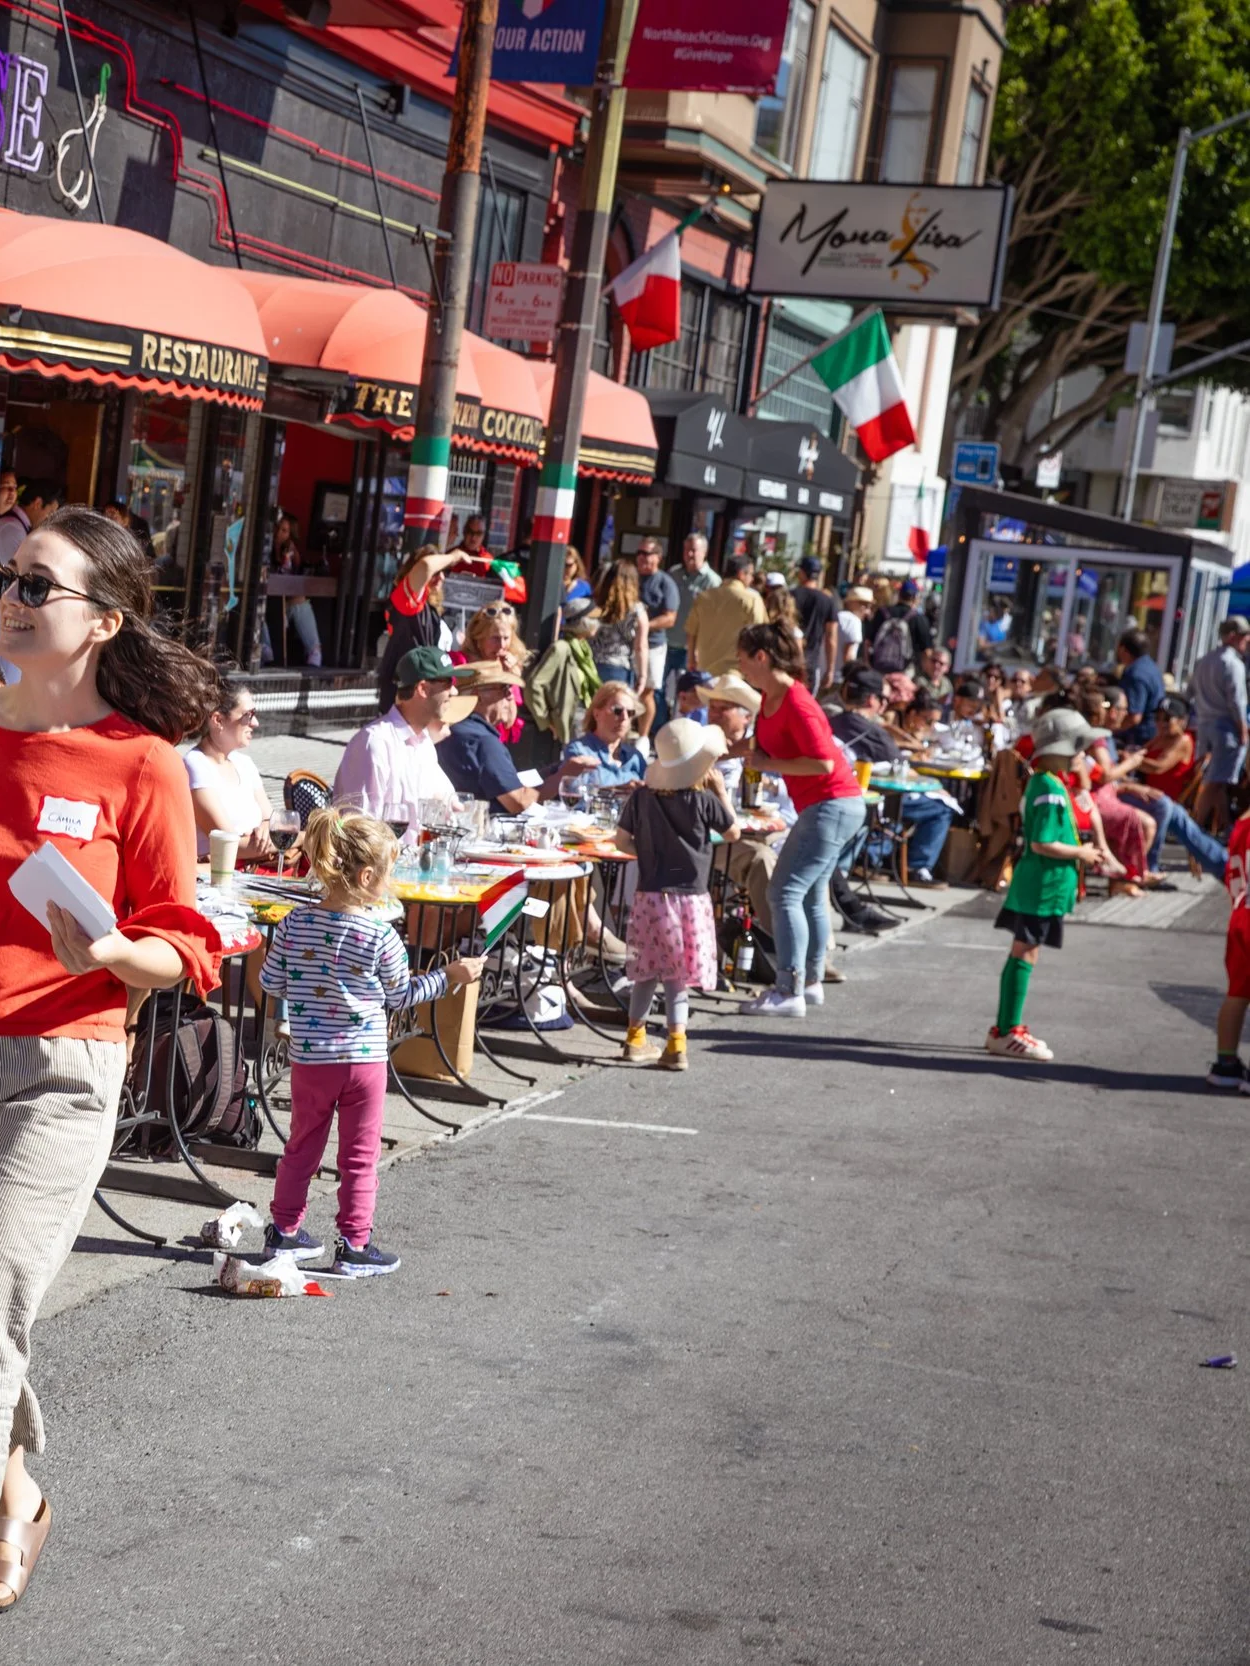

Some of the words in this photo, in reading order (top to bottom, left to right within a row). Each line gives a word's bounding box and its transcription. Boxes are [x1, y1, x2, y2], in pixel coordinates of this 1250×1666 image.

[529, 28, 586, 53] ACTION
[674, 47, 733, 64] #GiveHope
[779, 202, 894, 276] Mona
[887, 208, 983, 273] Lisa
[494, 265, 513, 284] NO
[517, 271, 559, 287] PARKING
[141, 333, 259, 390] RESTAURANT
[353, 381, 415, 418] THE
